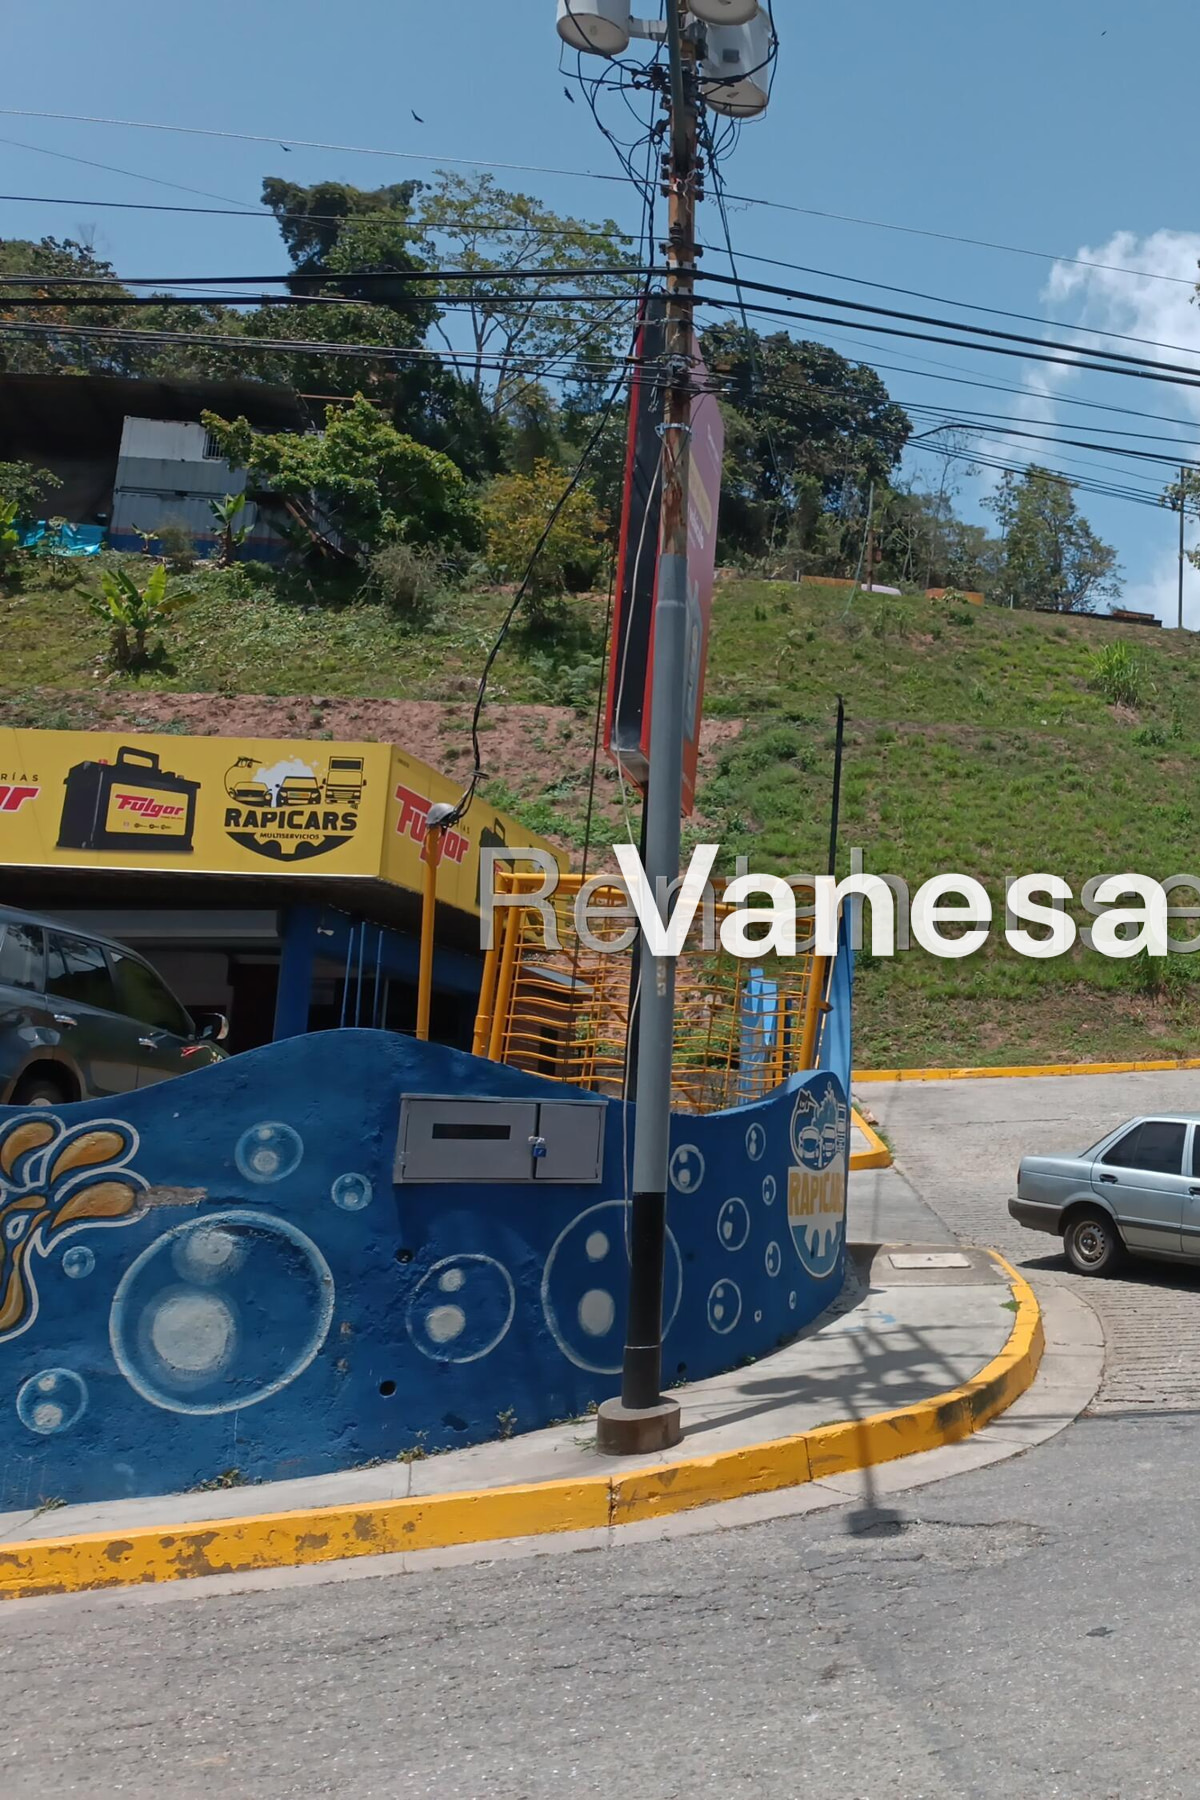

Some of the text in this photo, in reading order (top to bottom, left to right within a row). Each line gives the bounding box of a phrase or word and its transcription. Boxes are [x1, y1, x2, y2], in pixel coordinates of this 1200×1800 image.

[115, 793, 185, 818] Fulgor
[224, 808, 358, 831] RAPICARS
[259, 832, 320, 840] MULTISERVICIOS
